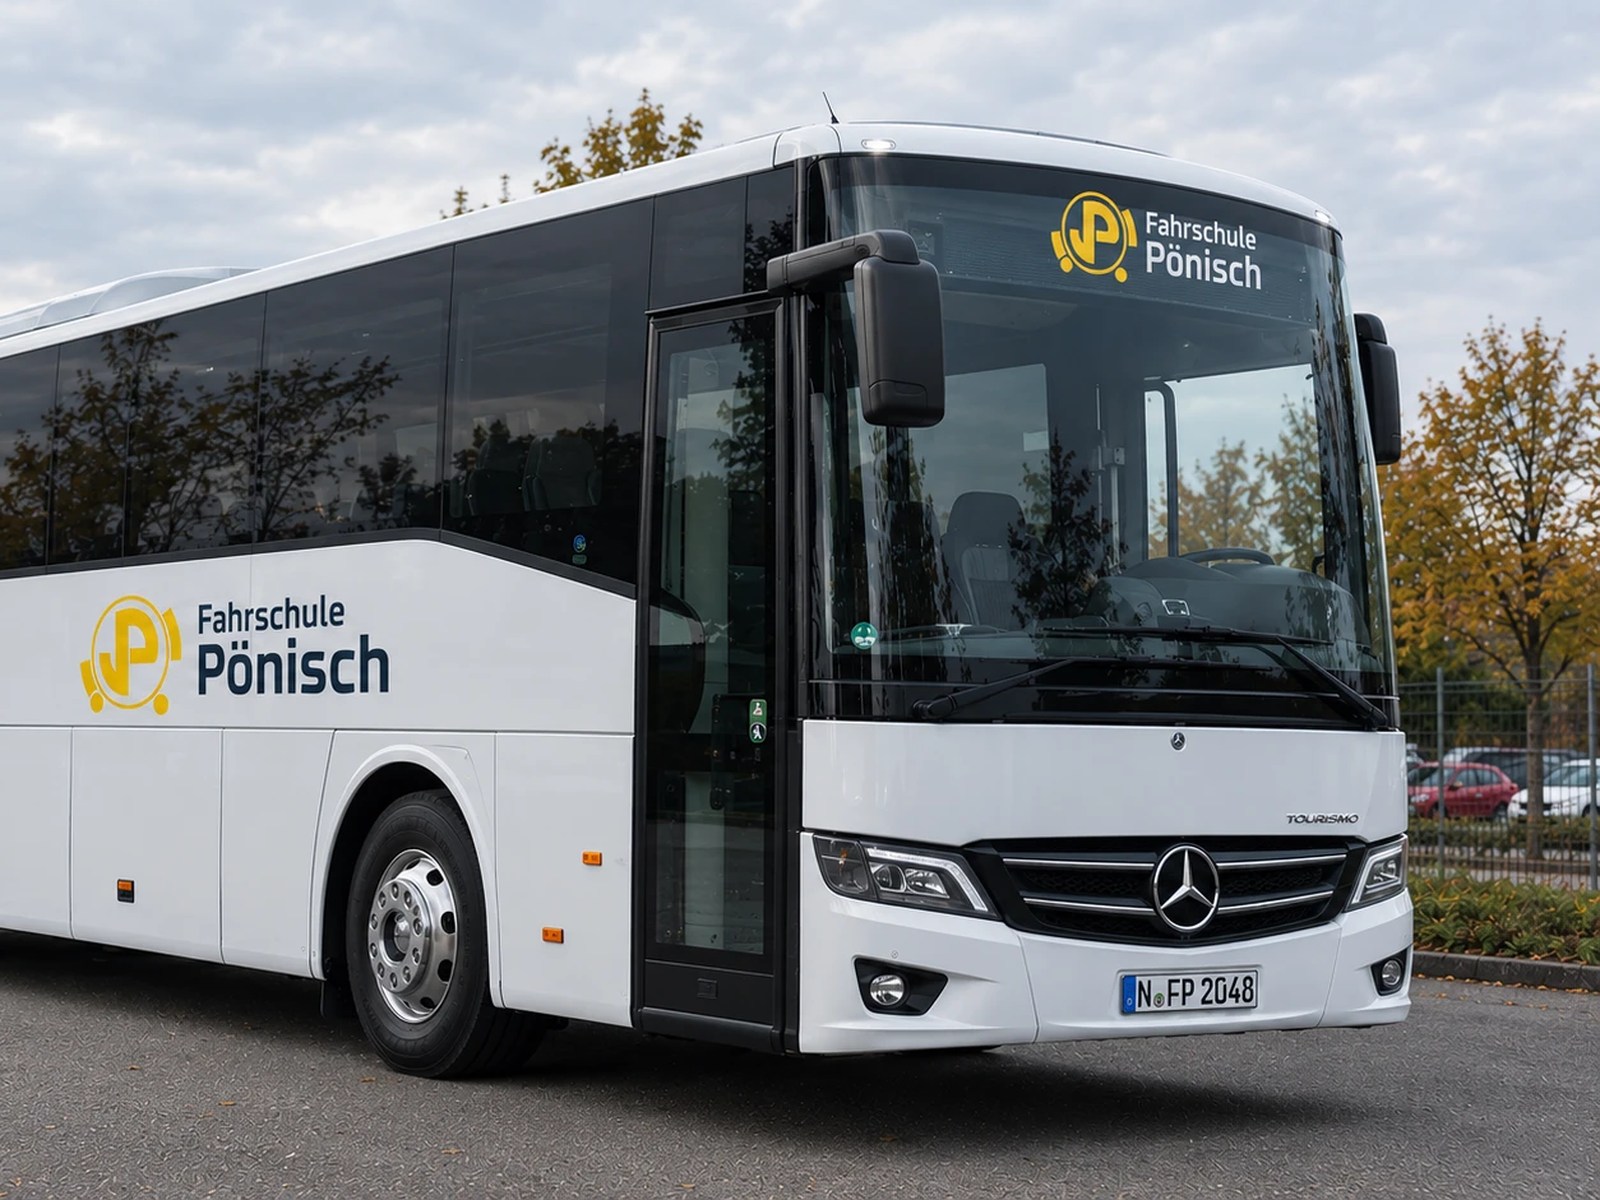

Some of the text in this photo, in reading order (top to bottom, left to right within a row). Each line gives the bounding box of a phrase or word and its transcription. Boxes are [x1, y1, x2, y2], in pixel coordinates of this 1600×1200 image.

[1145, 211, 1257, 250] Fahrschule
[1145, 240, 1262, 290] Pönisch
[198, 594, 345, 634] Fahrschule
[198, 634, 390, 696] Pönisch
[1286, 813, 1359, 824] TOURISMO
[1137, 975, 1254, 1008] N FP 2048
